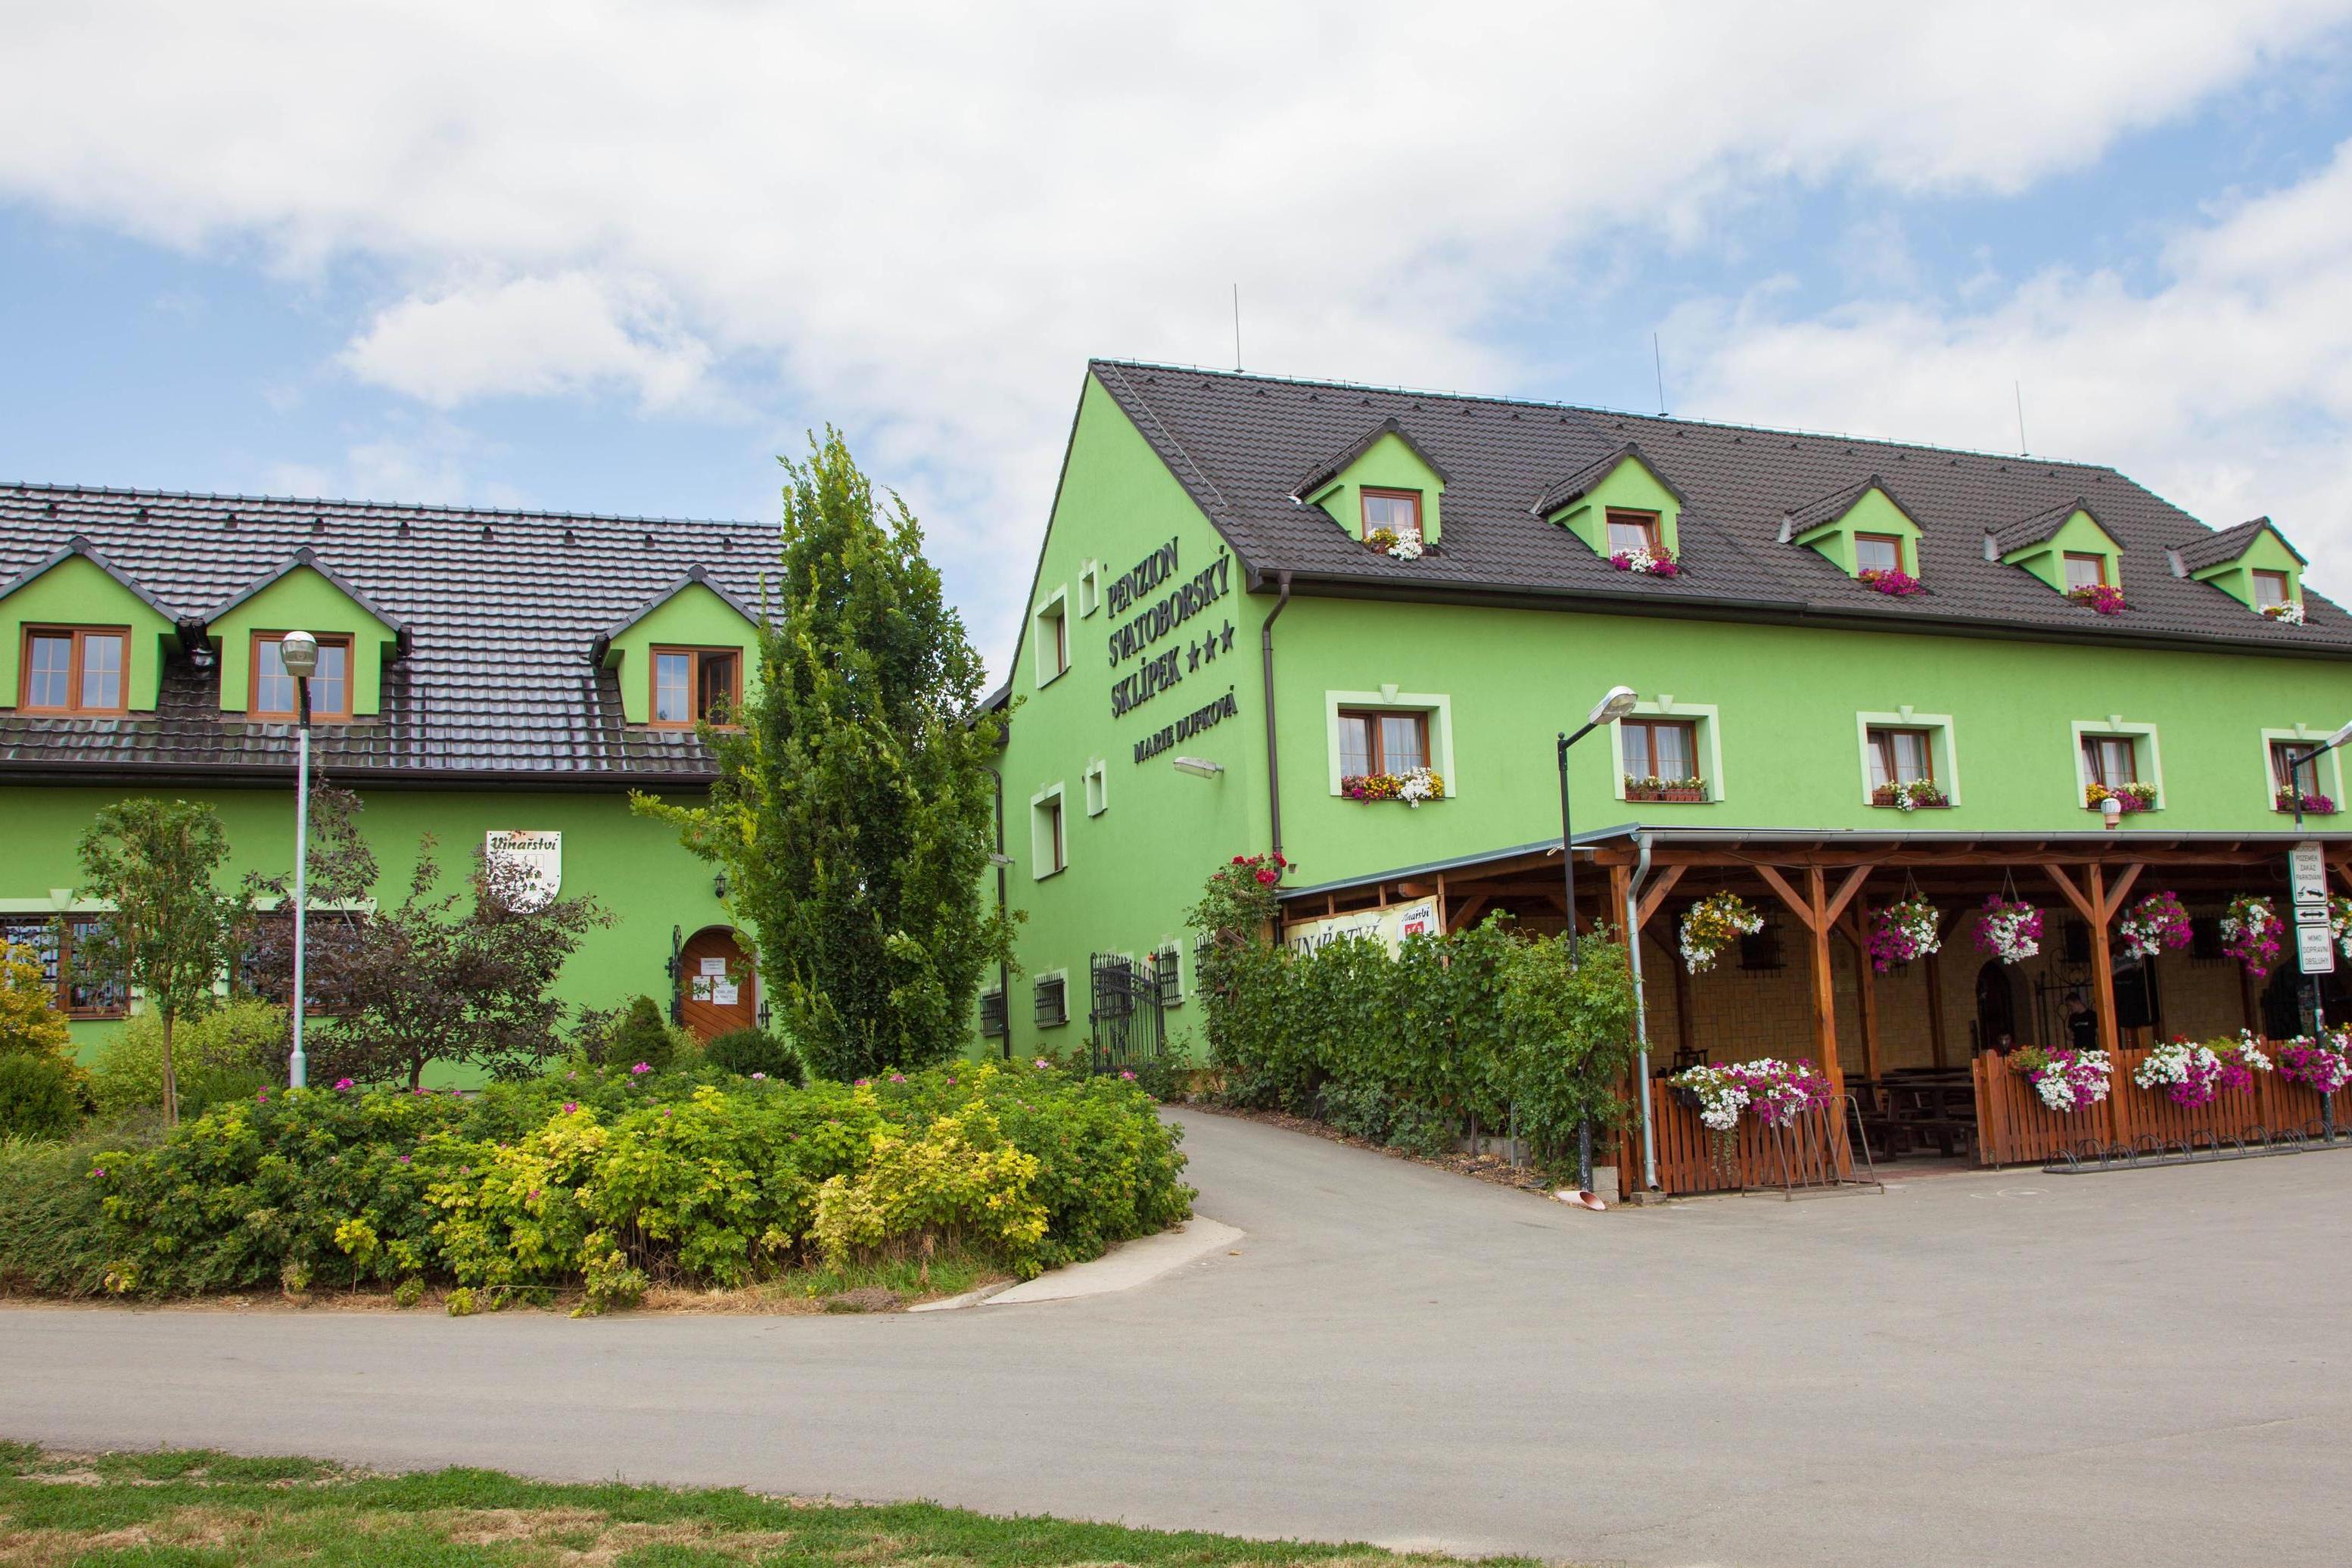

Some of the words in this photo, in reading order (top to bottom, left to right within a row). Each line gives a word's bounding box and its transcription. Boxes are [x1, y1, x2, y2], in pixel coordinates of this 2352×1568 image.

[1106, 536, 1178, 619] PENZION
[1109, 544, 1230, 668] SVATOBORSKÝ
[1111, 646, 1183, 719] SKLÍPEK
[1134, 724, 1174, 764] MARIE
[1175, 684, 1239, 743] DUFKOVÁ
[490, 837, 558, 851] Vinařství
